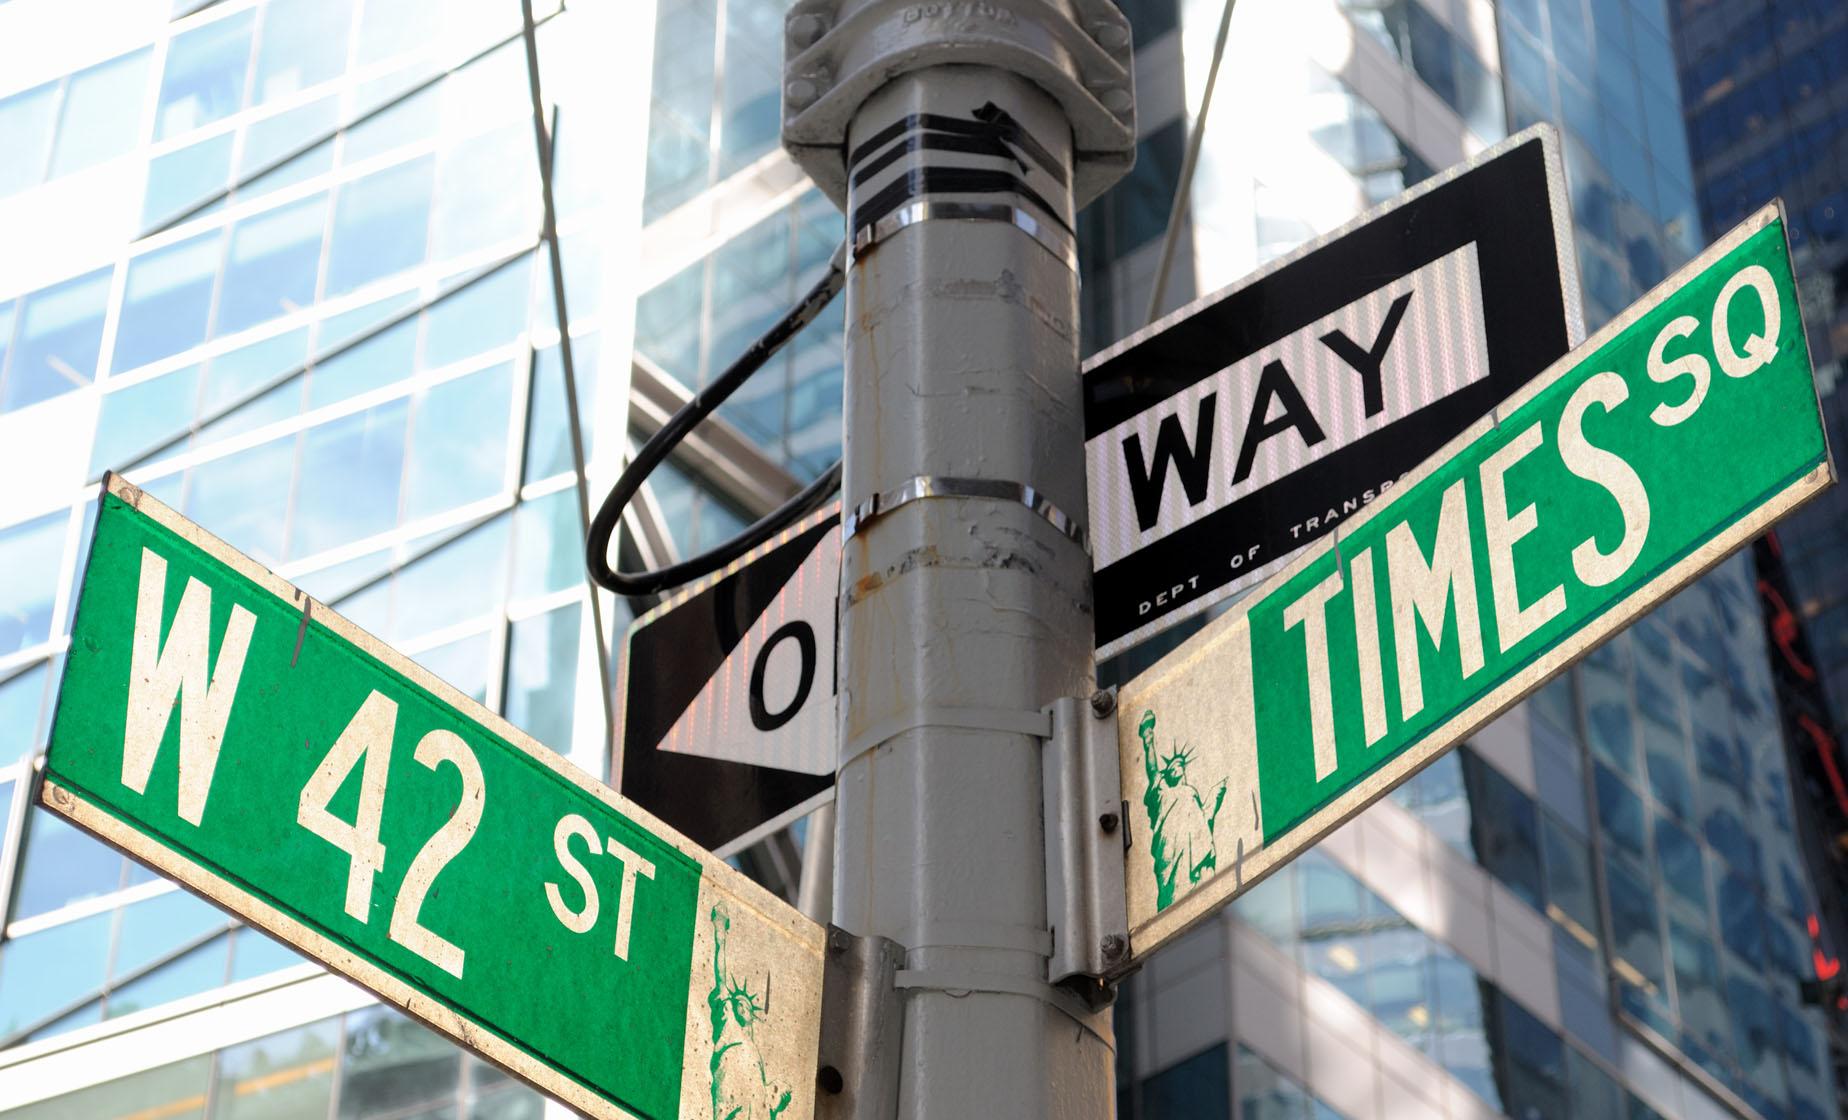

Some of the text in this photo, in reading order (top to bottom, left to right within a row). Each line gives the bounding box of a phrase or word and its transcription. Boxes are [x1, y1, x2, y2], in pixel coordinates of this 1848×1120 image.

[1122, 290, 1416, 534] WAY
[1138, 575, 1200, 616] DEPT
[1230, 544, 1261, 569] OF
[1283, 264, 1782, 784] TIMES SQ
[121, 546, 656, 980] W 42 ST
